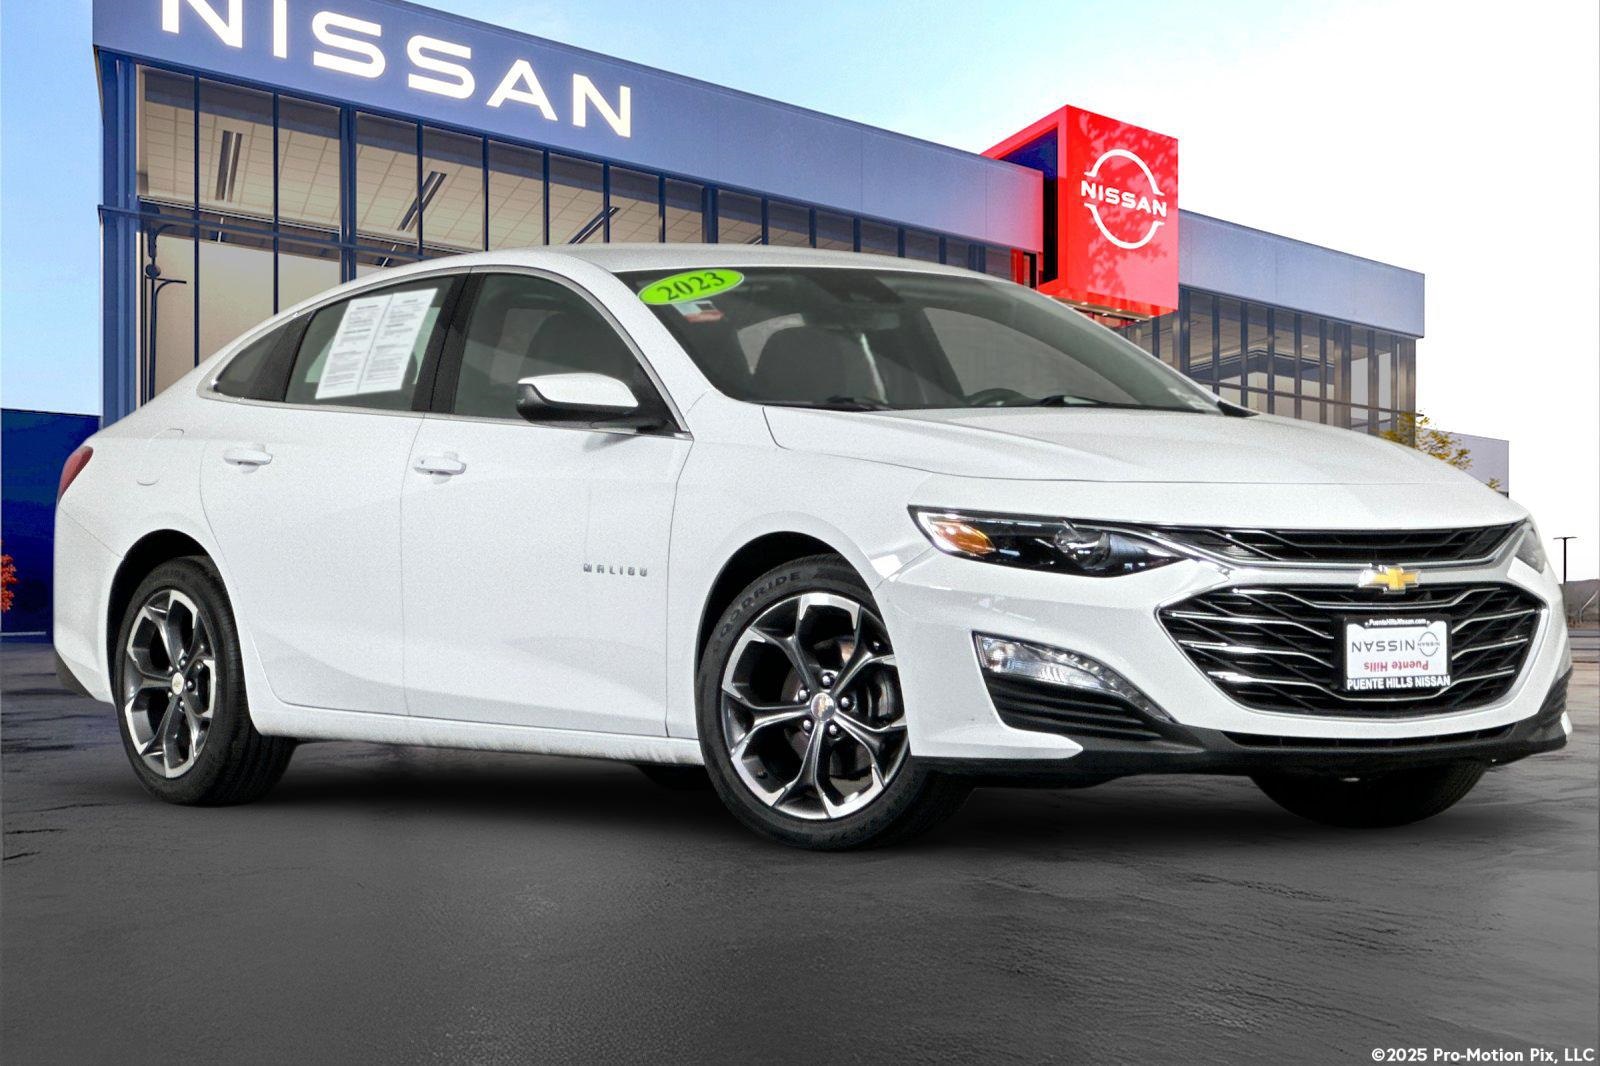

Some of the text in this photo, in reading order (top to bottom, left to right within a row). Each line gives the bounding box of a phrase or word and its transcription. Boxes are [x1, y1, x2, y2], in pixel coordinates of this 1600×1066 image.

[162, 0, 632, 138] NISSAN
[1081, 180, 1167, 217] NISSAN
[657, 272, 725, 301] 2023
[583, 563, 648, 577] MALIBU
[1352, 639, 1415, 653] NISSAN
[1363, 660, 1429, 672] Puente Hills
[1347, 675, 1451, 690] PUENTE HILLS NISSAN
